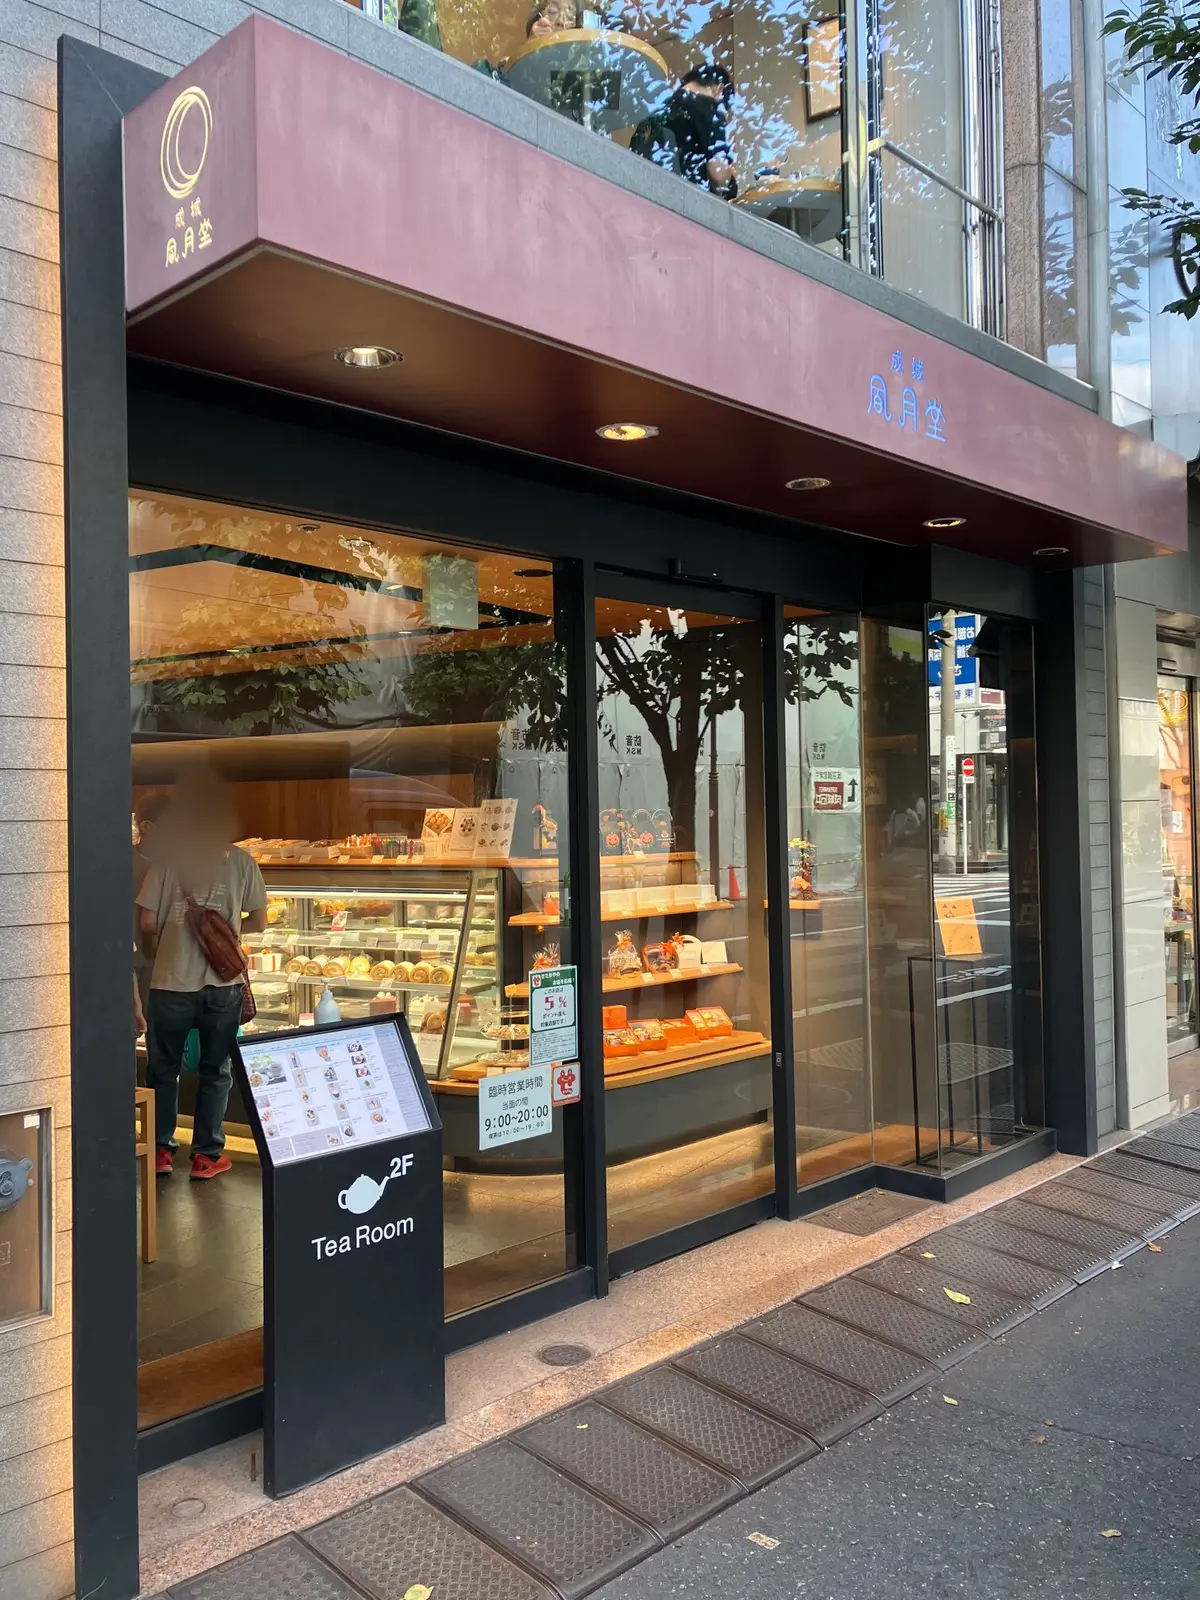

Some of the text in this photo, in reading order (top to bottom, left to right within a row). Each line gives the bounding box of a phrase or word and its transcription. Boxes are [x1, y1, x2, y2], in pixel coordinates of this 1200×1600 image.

[890, 349, 925, 384] 成城
[867, 373, 946, 443] 風月堂
[488, 1076, 543, 1099] 臨時営業時間
[502, 1096, 529, 1111] 当面の間
[390, 1153, 414, 1179] 2F
[311, 1216, 414, 1261] Tea Room
